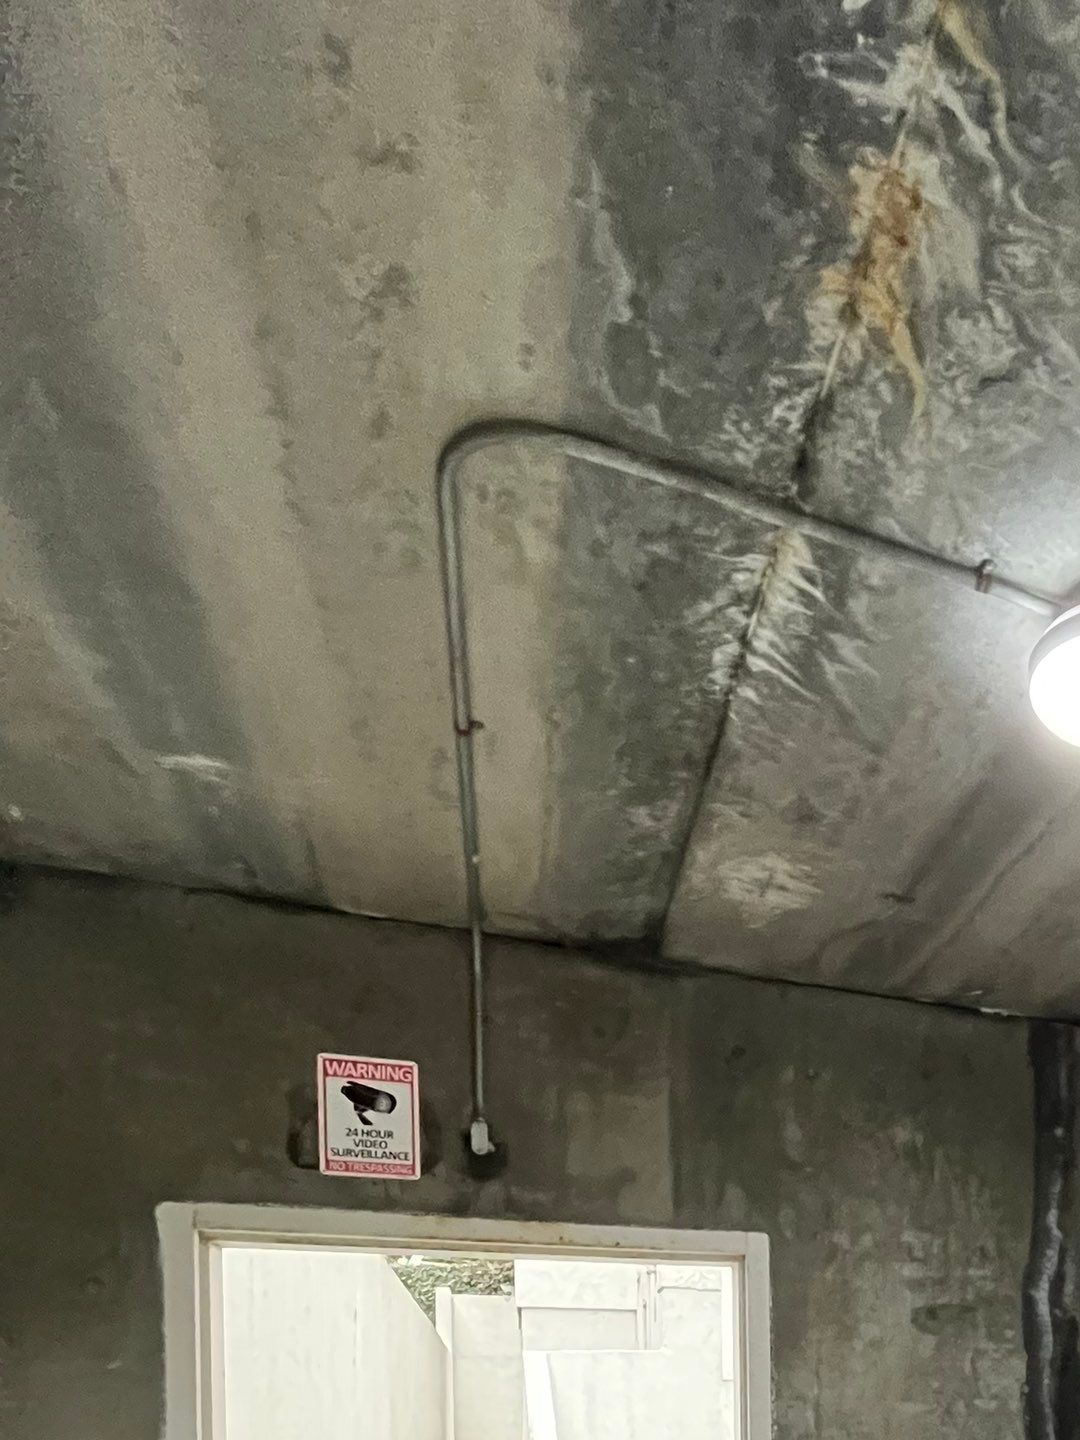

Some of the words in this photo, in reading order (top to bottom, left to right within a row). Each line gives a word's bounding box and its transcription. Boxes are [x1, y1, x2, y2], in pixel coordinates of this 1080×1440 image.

[325, 1060, 413, 1082] WARNING
[345, 1127, 359, 1137] 24
[361, 1128, 394, 1140] HOUR
[353, 1139, 388, 1150] VIDEO
[330, 1147, 411, 1161] SURVEILLANCE
[329, 1161, 345, 1171] NO
[347, 1162, 413, 1175] TRESPASSING
